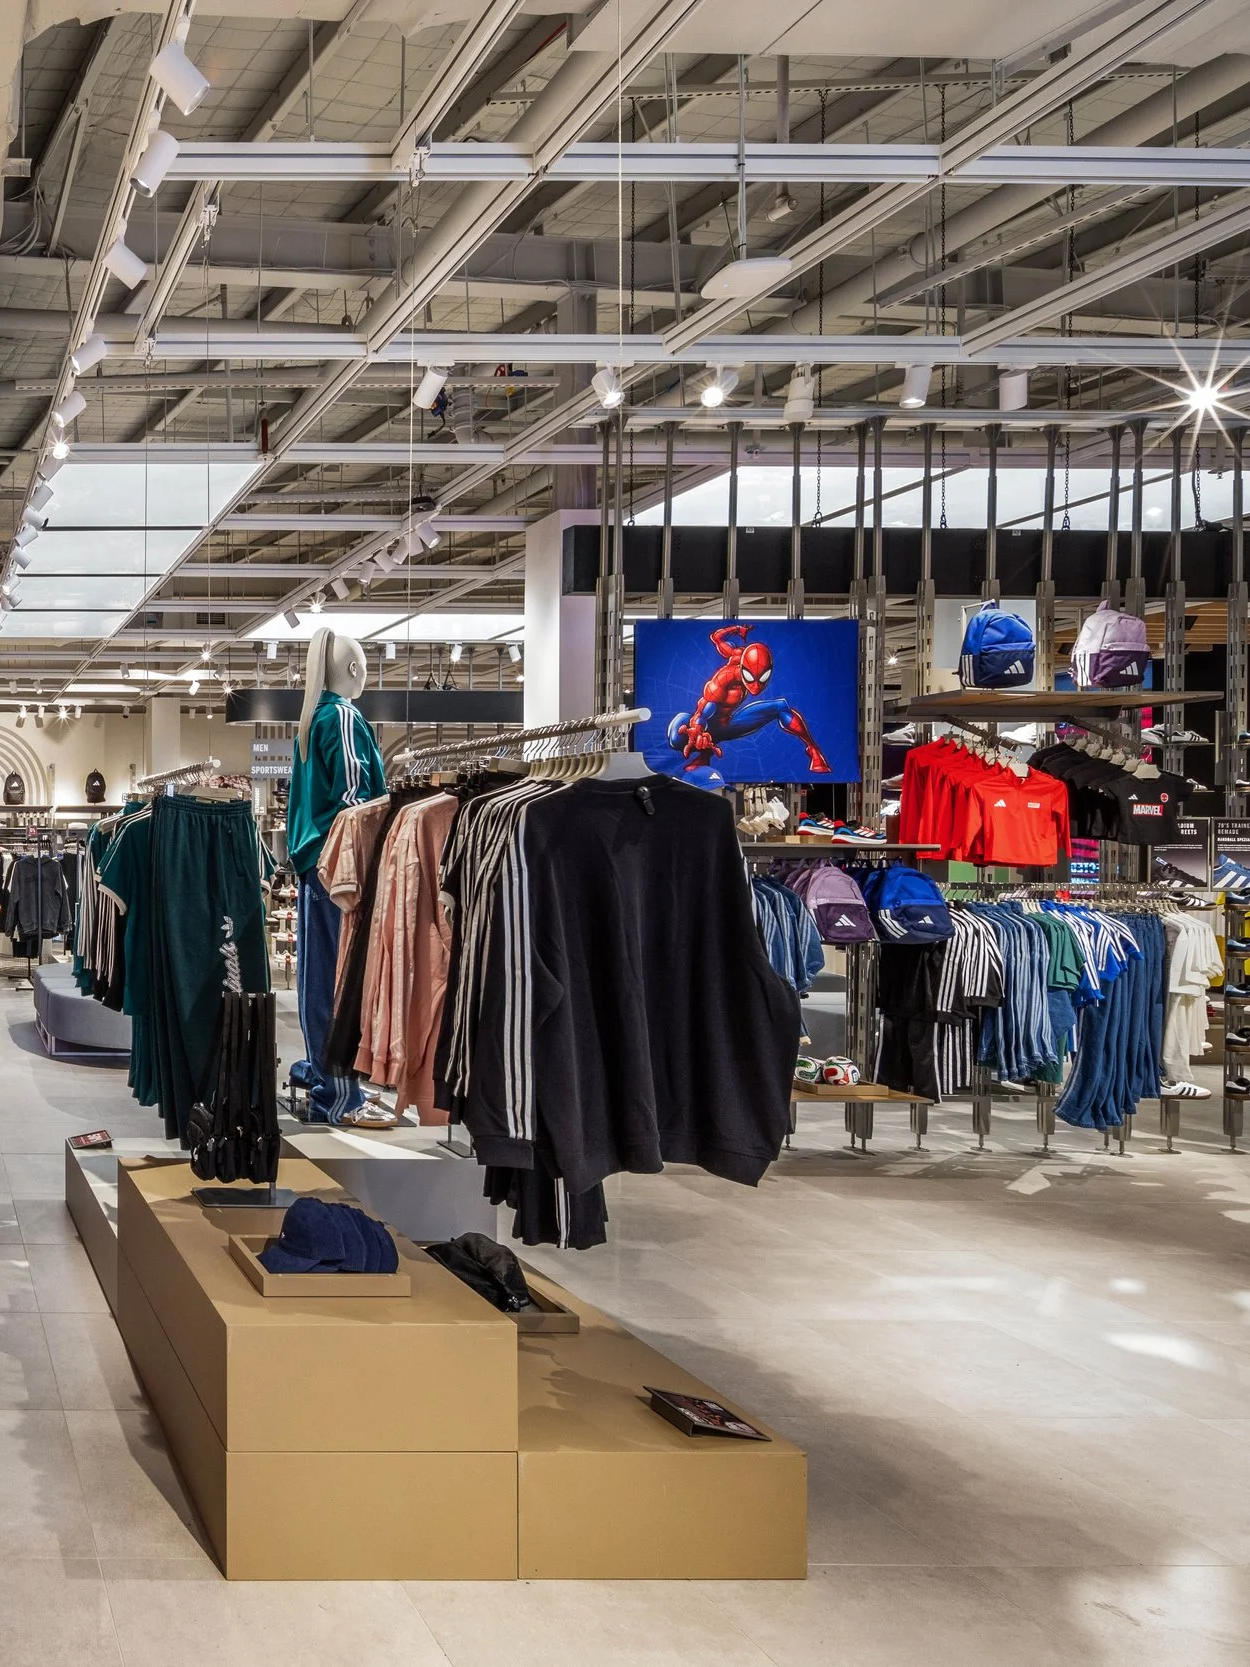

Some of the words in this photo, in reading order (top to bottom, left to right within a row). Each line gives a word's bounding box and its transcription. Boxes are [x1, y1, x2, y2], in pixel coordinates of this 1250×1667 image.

[252, 743, 268, 752] MEN
[251, 766, 293, 775] SPORTSWEA
[1133, 804, 1162, 816] MARVEL
[219, 941, 243, 993] inals
